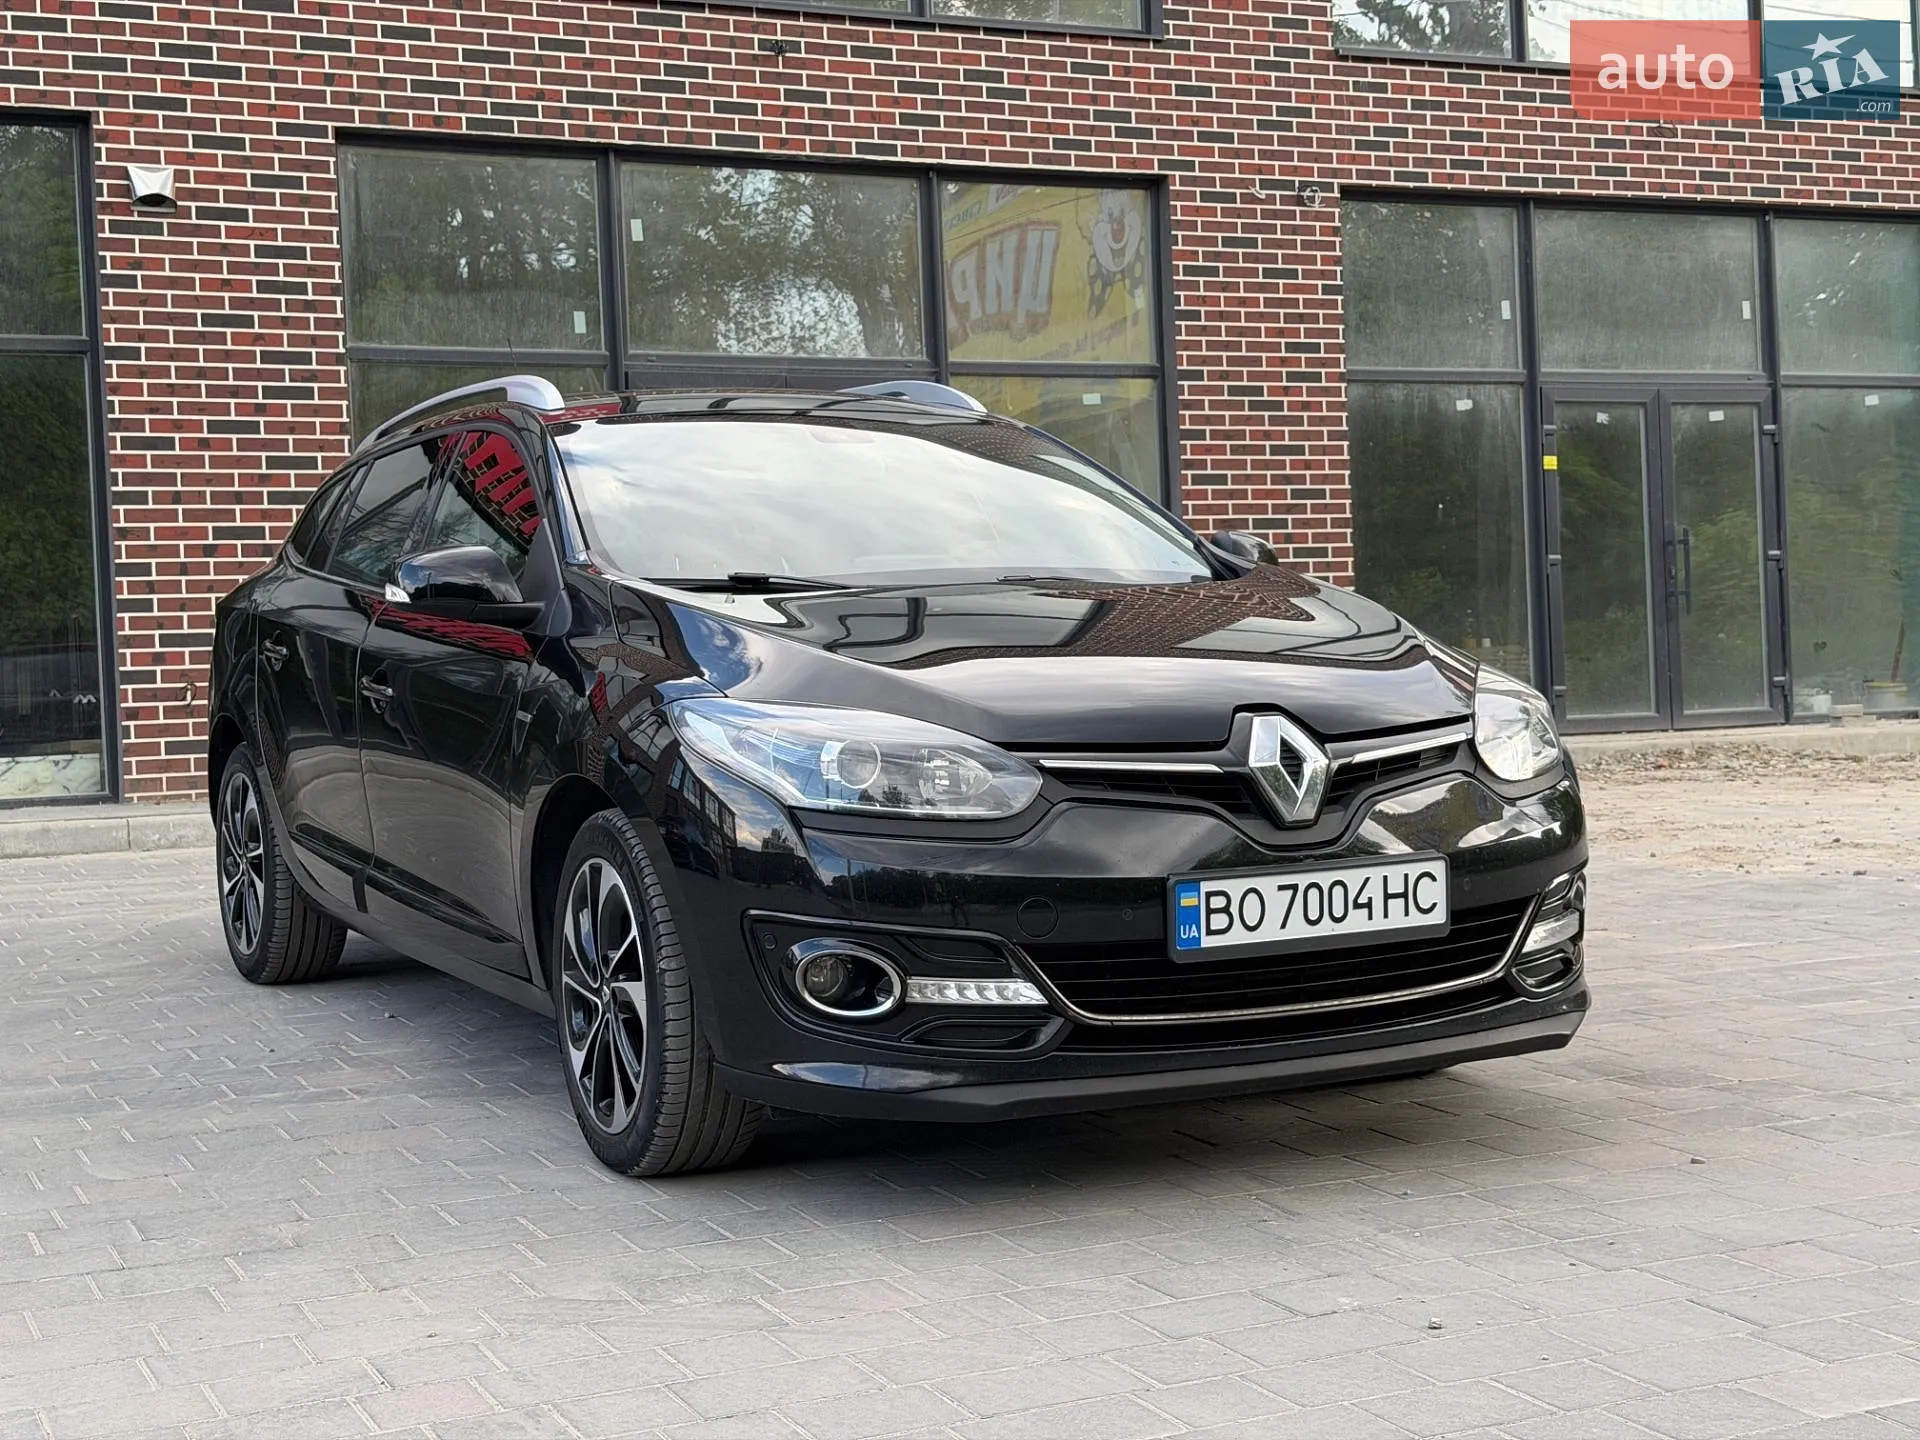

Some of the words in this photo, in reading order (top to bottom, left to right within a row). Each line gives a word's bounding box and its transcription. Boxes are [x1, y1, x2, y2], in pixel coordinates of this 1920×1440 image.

[1204, 886, 1266, 937] BO
[1276, 875, 1374, 930] 7004
[1382, 871, 1439, 919] HC
[1179, 924, 1200, 939] UA
